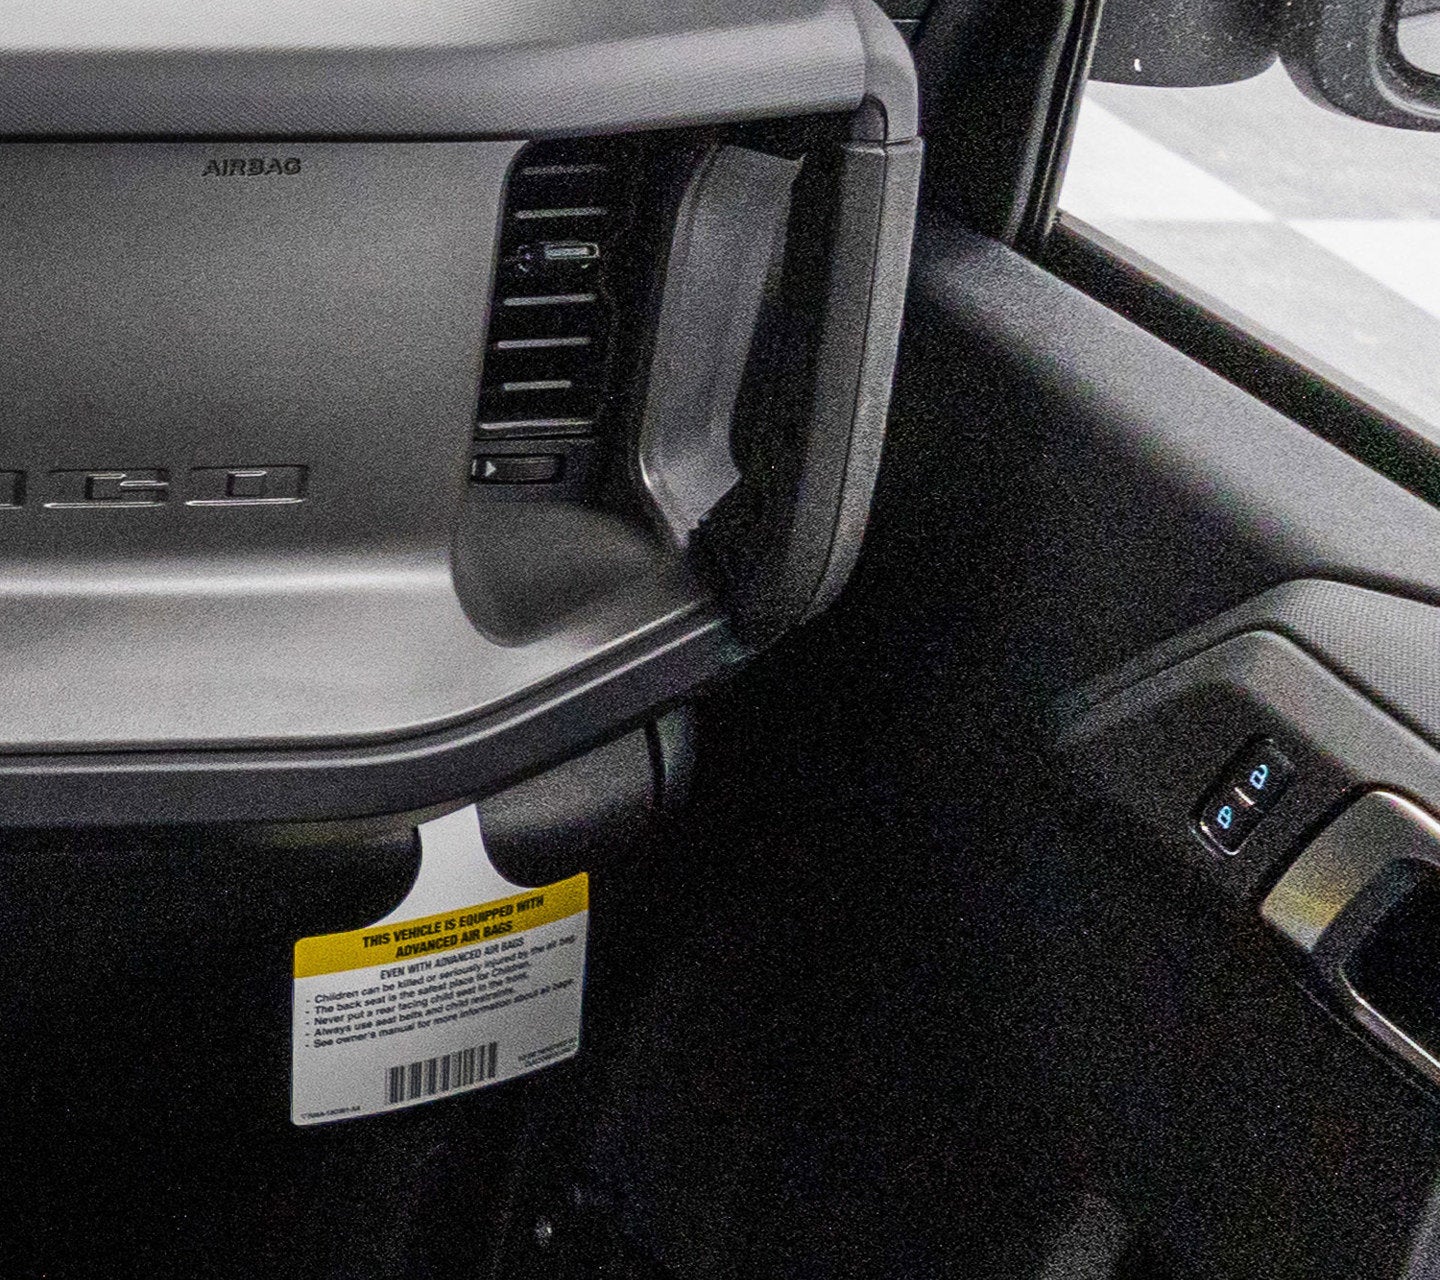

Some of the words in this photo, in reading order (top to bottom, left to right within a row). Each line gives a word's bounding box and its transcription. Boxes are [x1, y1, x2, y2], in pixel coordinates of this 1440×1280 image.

[201, 157, 303, 177] AIRBAG
[363, 933, 391, 948] THIS
[393, 921, 441, 942] VEHICLE
[444, 919, 457, 931] IS
[459, 904, 514, 927] EQUIPPED
[516, 895, 544, 913] WITH
[396, 934, 458, 959] ADVANCED
[461, 928, 480, 943] AIR
[483, 921, 514, 938] BAGS
[380, 966, 405, 980] EVEN
[407, 961, 432, 974] WITH
[435, 948, 482, 967] ADVANCED
[314, 989, 359, 1003] Children
[361, 986, 380, 996] can
[382, 982, 395, 992] be
[398, 976, 424, 988] killed
[315, 1005, 334, 1015] The
[336, 1001, 361, 1012] back
[364, 996, 386, 1007] seat
[399, 990, 415, 999] the
[314, 1015, 344, 1026] Never
[347, 1010, 365, 1022] put
[375, 1005, 395, 1016] rear
[314, 1025, 351, 1037] Always
[354, 1021, 373, 1030] use
[314, 1038, 334, 1048] See
